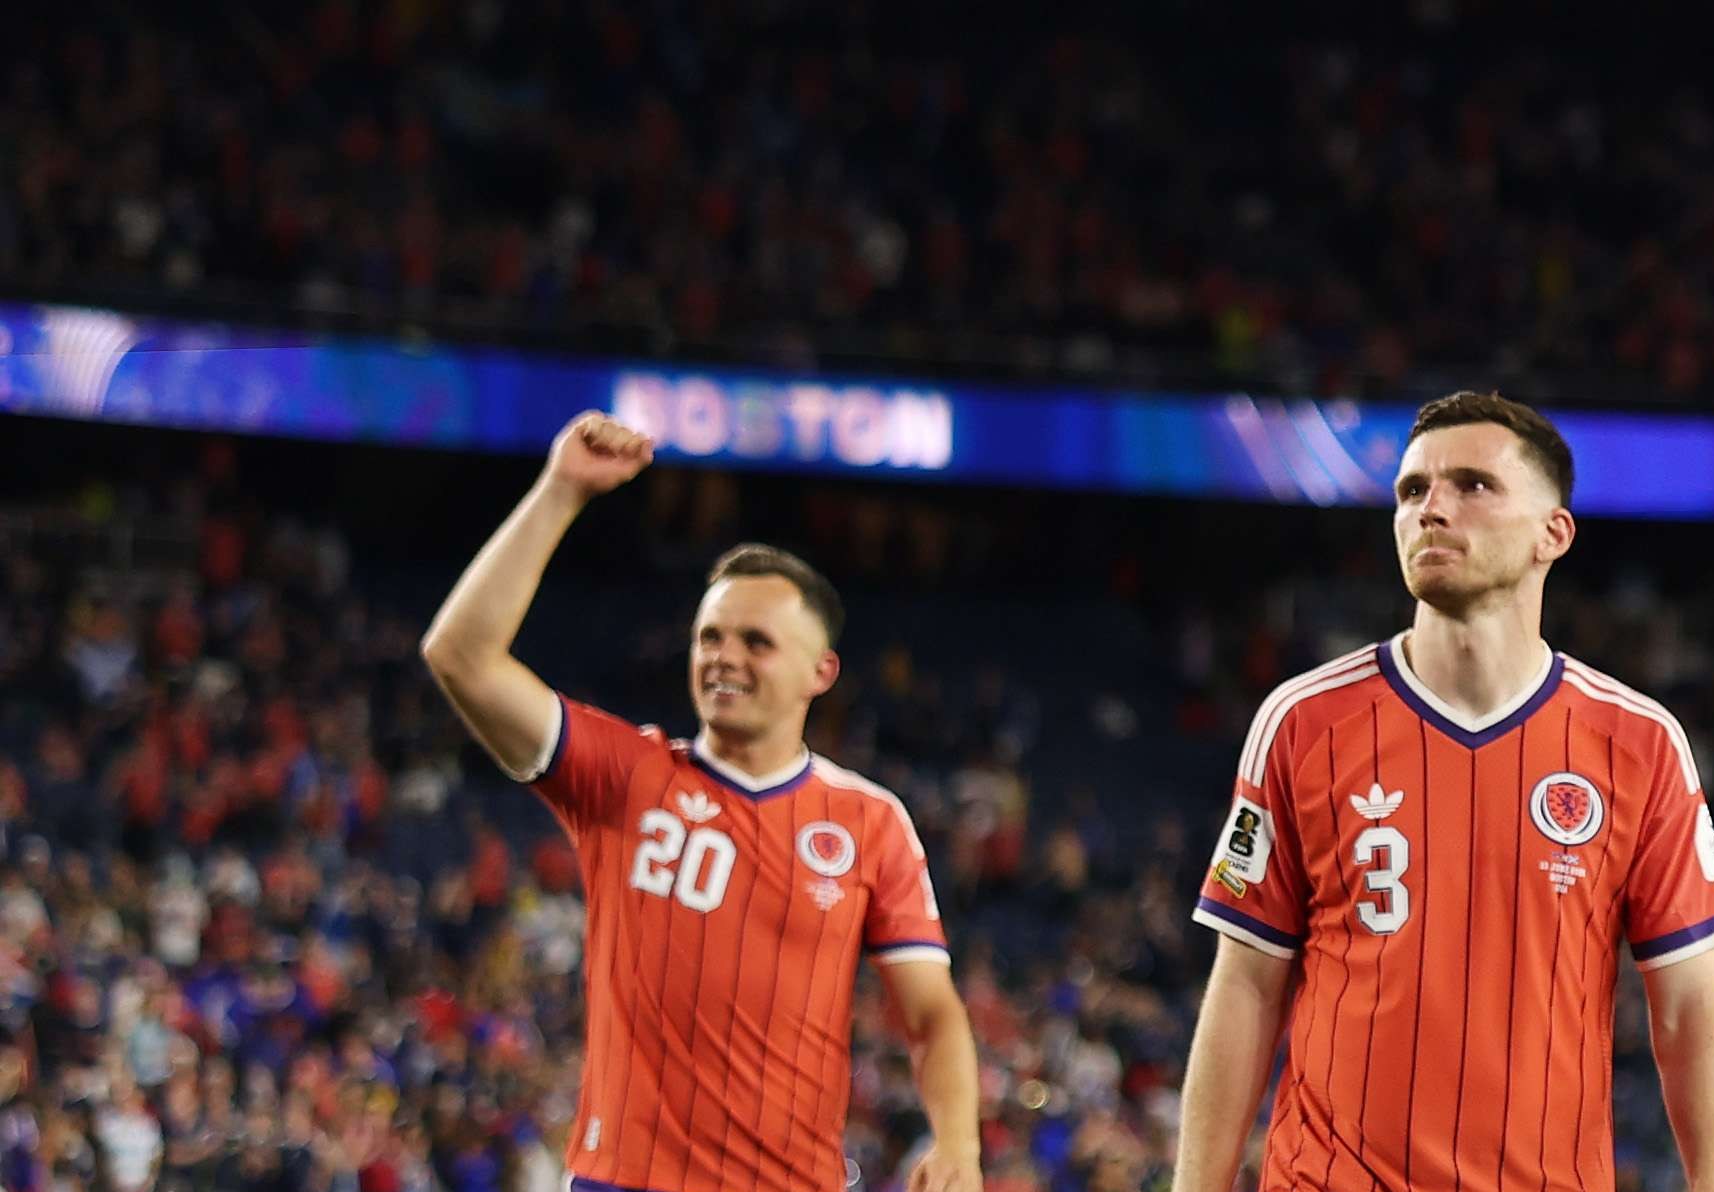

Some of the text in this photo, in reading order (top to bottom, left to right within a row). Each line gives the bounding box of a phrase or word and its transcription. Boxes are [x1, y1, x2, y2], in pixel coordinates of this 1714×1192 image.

[613, 374, 952, 470] BOSTON
[630, 807, 737, 914] 20
[1353, 826, 1412, 936] 3
